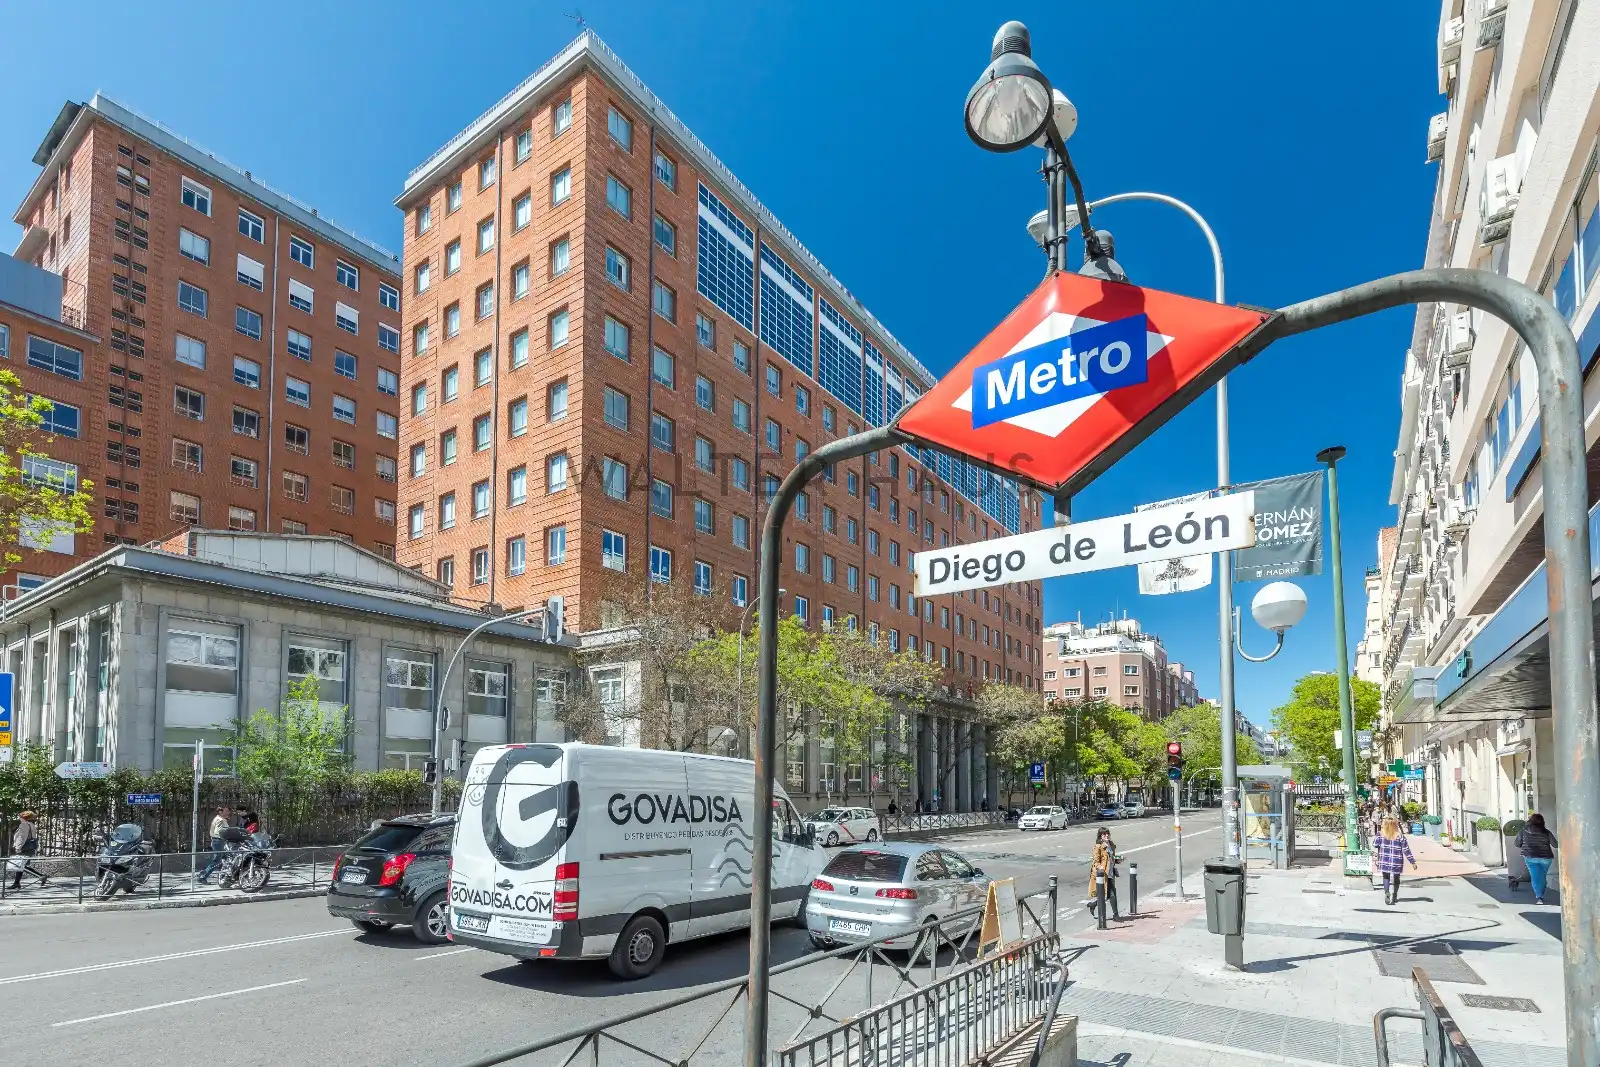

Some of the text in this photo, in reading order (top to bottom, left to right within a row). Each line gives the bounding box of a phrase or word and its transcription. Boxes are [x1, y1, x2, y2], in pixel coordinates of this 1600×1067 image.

[987, 340, 1132, 410] Metro
[1254, 505, 1313, 527] ERNÁN
[929, 511, 1230, 585] Diego de León
[1266, 566, 1300, 576] MADRID
[482, 744, 580, 871] G
[607, 793, 743, 825] GOVADISA
[451, 885, 553, 914] GOVADISA.COM
